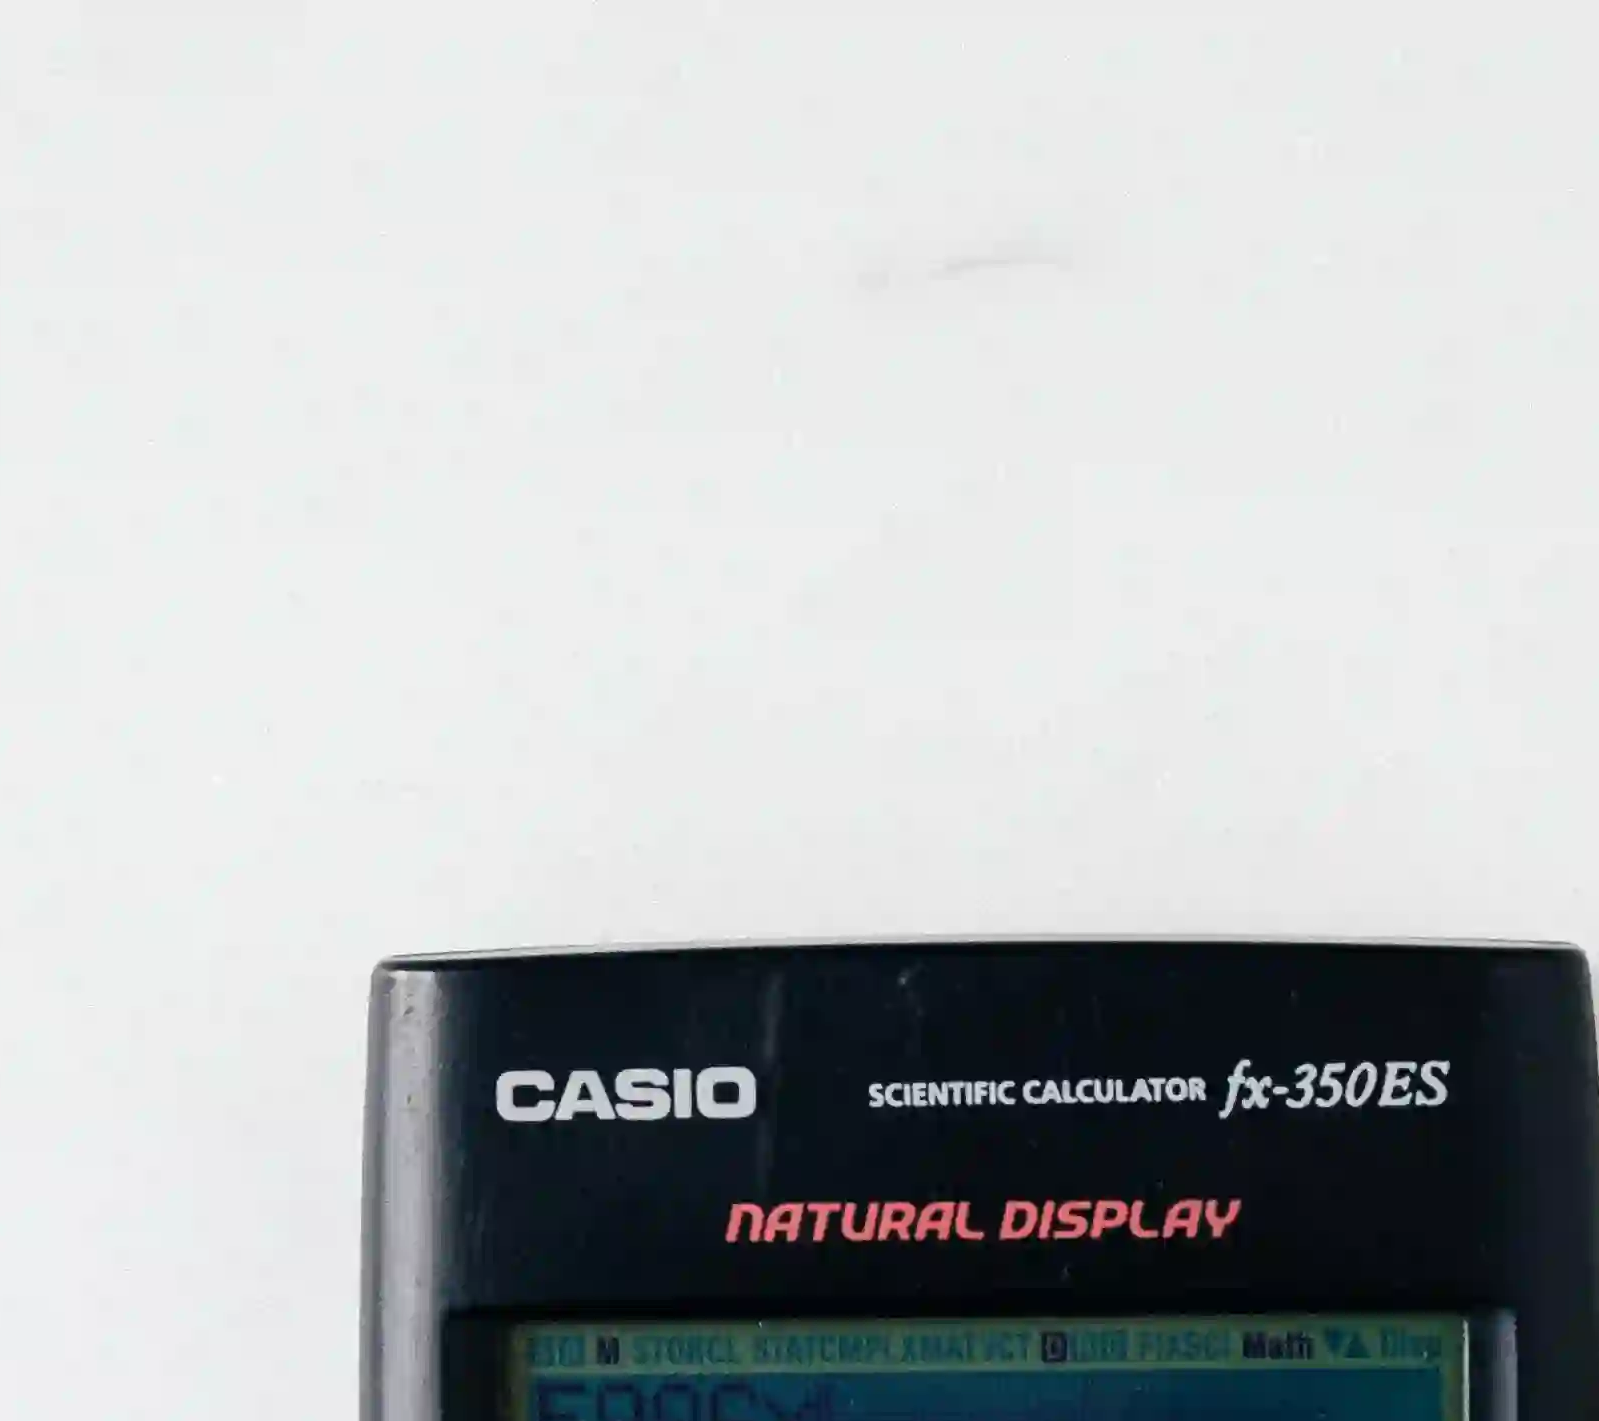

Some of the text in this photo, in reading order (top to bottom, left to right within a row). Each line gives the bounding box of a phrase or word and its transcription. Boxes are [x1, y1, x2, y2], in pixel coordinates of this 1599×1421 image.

[496, 1067, 756, 1121] CASIO
[869, 1060, 1450, 1118] SCIENTIFIC CALCULATOR fx-350ES
[726, 1200, 1240, 1242] NATURAL DISPLAY
[1241, 1332, 1315, 1360] Math
